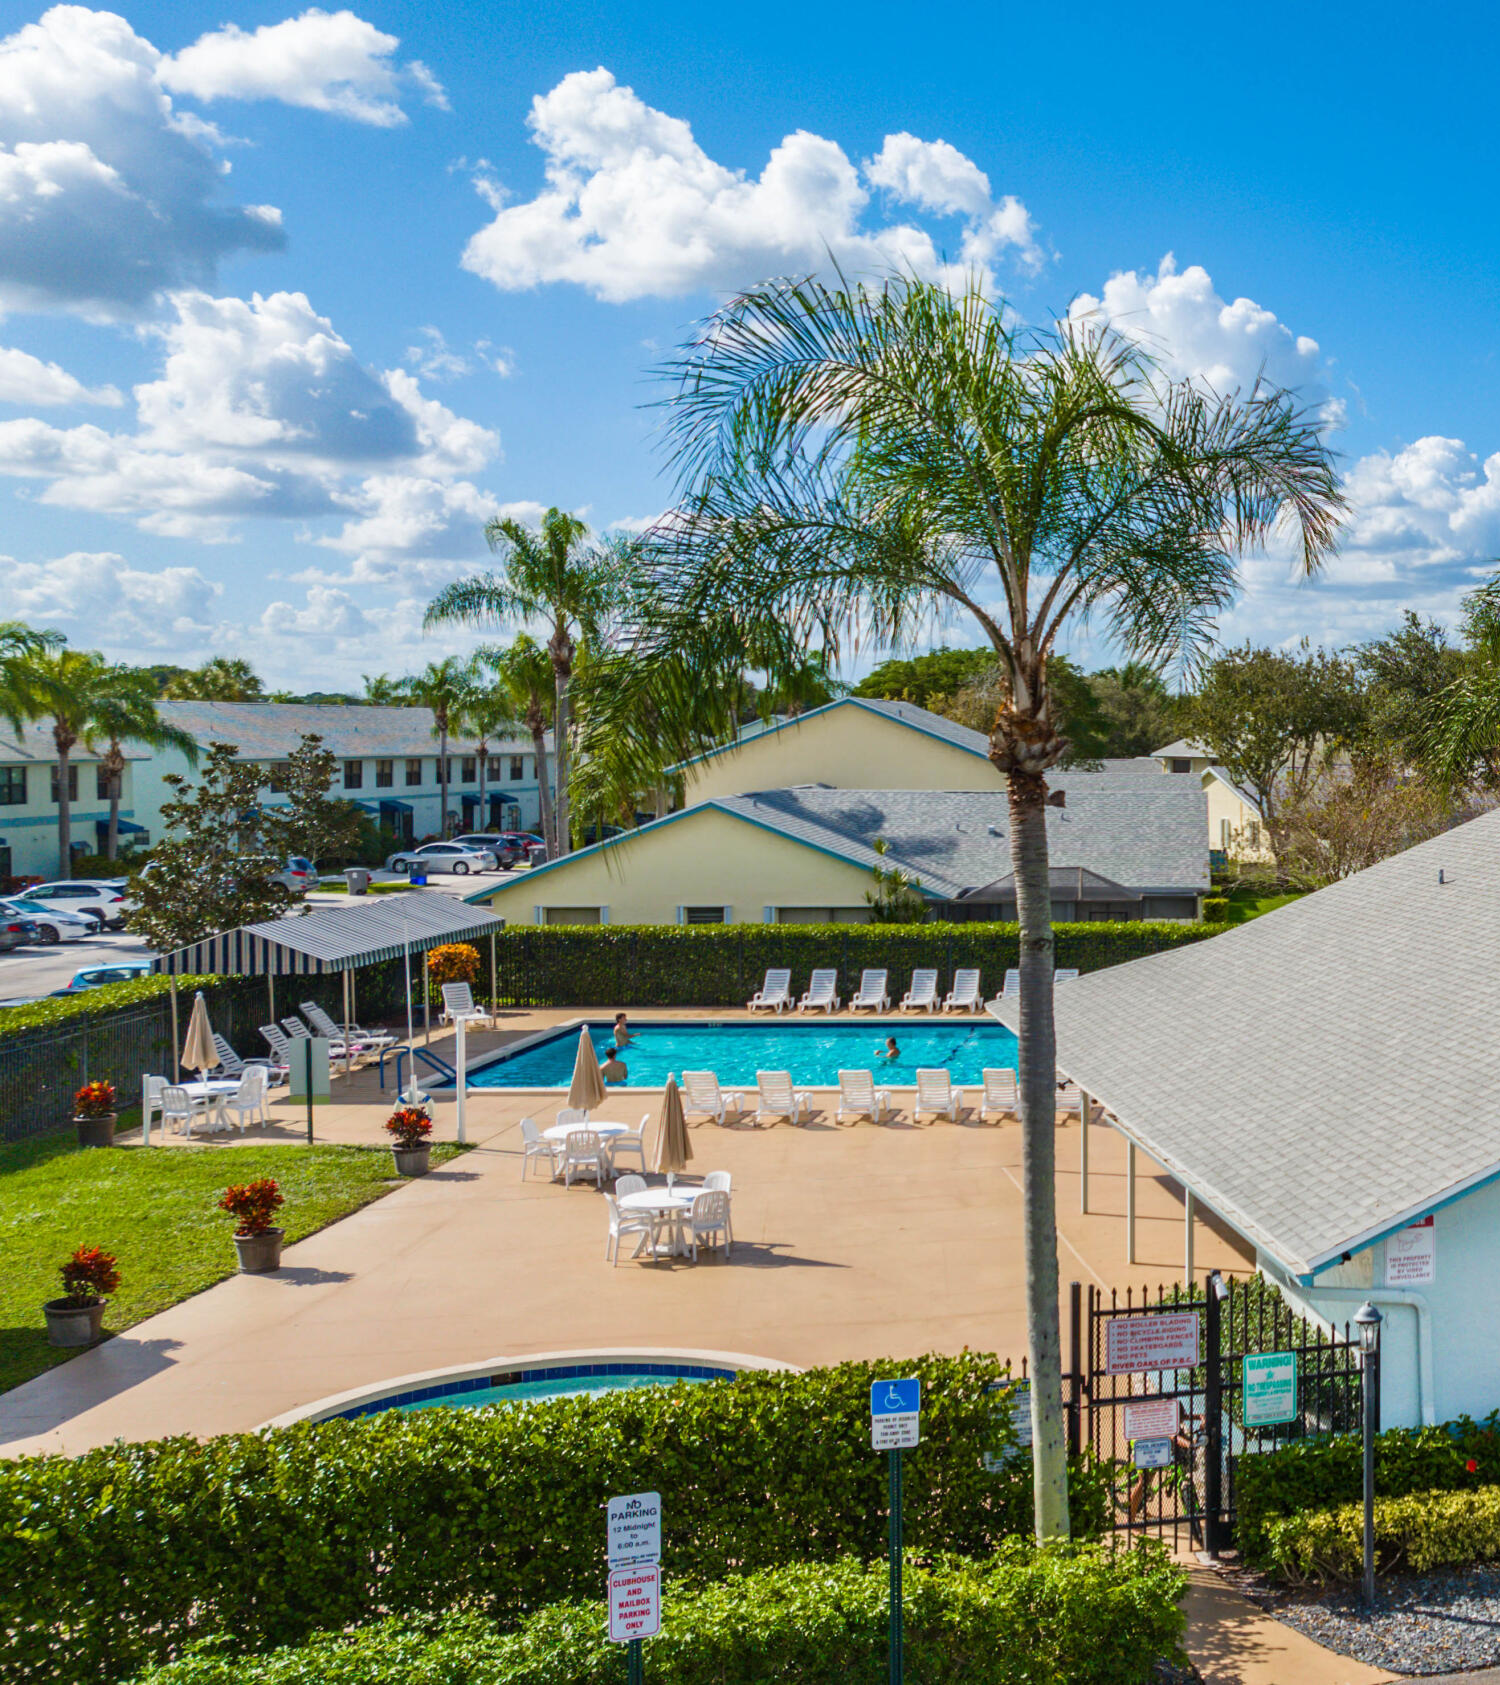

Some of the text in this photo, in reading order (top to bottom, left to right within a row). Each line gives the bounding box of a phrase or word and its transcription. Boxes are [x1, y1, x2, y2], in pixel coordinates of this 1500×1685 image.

[1390, 1272, 1430, 1280] SURVEILLANCE
[1129, 1321, 1158, 1329] ROLLER
[1160, 1318, 1192, 1326] BLADING
[1129, 1328, 1159, 1336] BICYCLE
[1129, 1335, 1164, 1343] CLIMBING
[1166, 1332, 1194, 1340] FENCES
[1130, 1342, 1183, 1351] SKATEBOARDS
[1137, 1360, 1158, 1368] OAKS
[1248, 1355, 1292, 1371] WARNING!
[1248, 1379, 1292, 1392] NO TRESPASSING
[626, 1501, 641, 1510] NO
[611, 1507, 657, 1520] PARKING
[624, 1522, 655, 1531] Midnight
[613, 1575, 656, 1588] CLUBHOUSE
[627, 1588, 642, 1596] AND
[618, 1598, 650, 1609] MAILBOX
[618, 1609, 650, 1620] PARKING
[625, 1621, 643, 1630] ONLY
